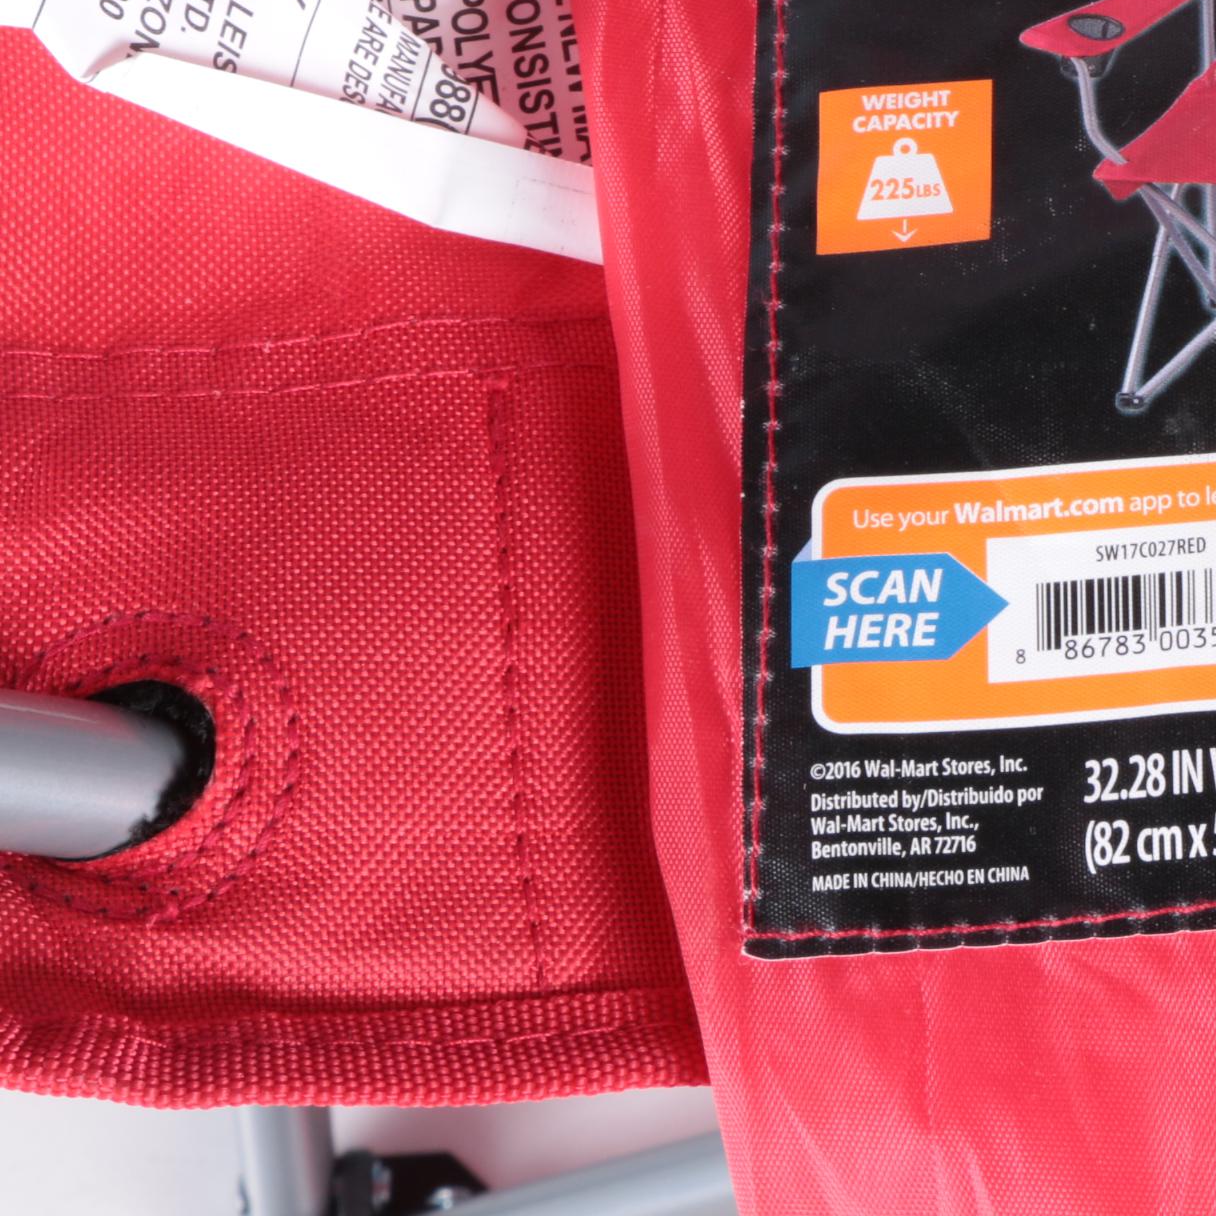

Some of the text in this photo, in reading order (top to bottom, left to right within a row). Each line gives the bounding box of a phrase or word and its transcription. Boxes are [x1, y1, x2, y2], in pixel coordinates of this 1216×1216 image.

[354, 15, 388, 66] ARE
[374, 31, 422, 115] MANUFA
[861, 90, 952, 111] WEIGHT
[852, 110, 960, 133] CAPACITY
[853, 506, 895, 530] Use
[897, 506, 949, 533] your
[954, 492, 1125, 526] Walmart.com
[1130, 491, 1174, 518] app
[1176, 487, 1201, 509] to
[1094, 536, 1208, 563] SW17C027RED
[822, 568, 944, 608] SCAN
[823, 611, 942, 651] HERE
[1015, 648, 1027, 665] 8
[1063, 631, 1147, 662] 86783
[810, 755, 1029, 781] ©2016 Wal-Mart Stores, Inc.
[1083, 751, 1166, 804] 32.28
[1172, 748, 1204, 796] IN
[811, 785, 1045, 813] Distributed by/Distribuido por
[810, 811, 980, 836] Wal-Mart Stores, Inc.,
[811, 835, 977, 860] Bentonville, AR 72716
[1084, 818, 1132, 875] (82
[1136, 828, 1184, 862] cm
[1186, 823, 1209, 858] x
[811, 864, 1031, 892] MADE IN CHINA/HECHO EN CHINA
